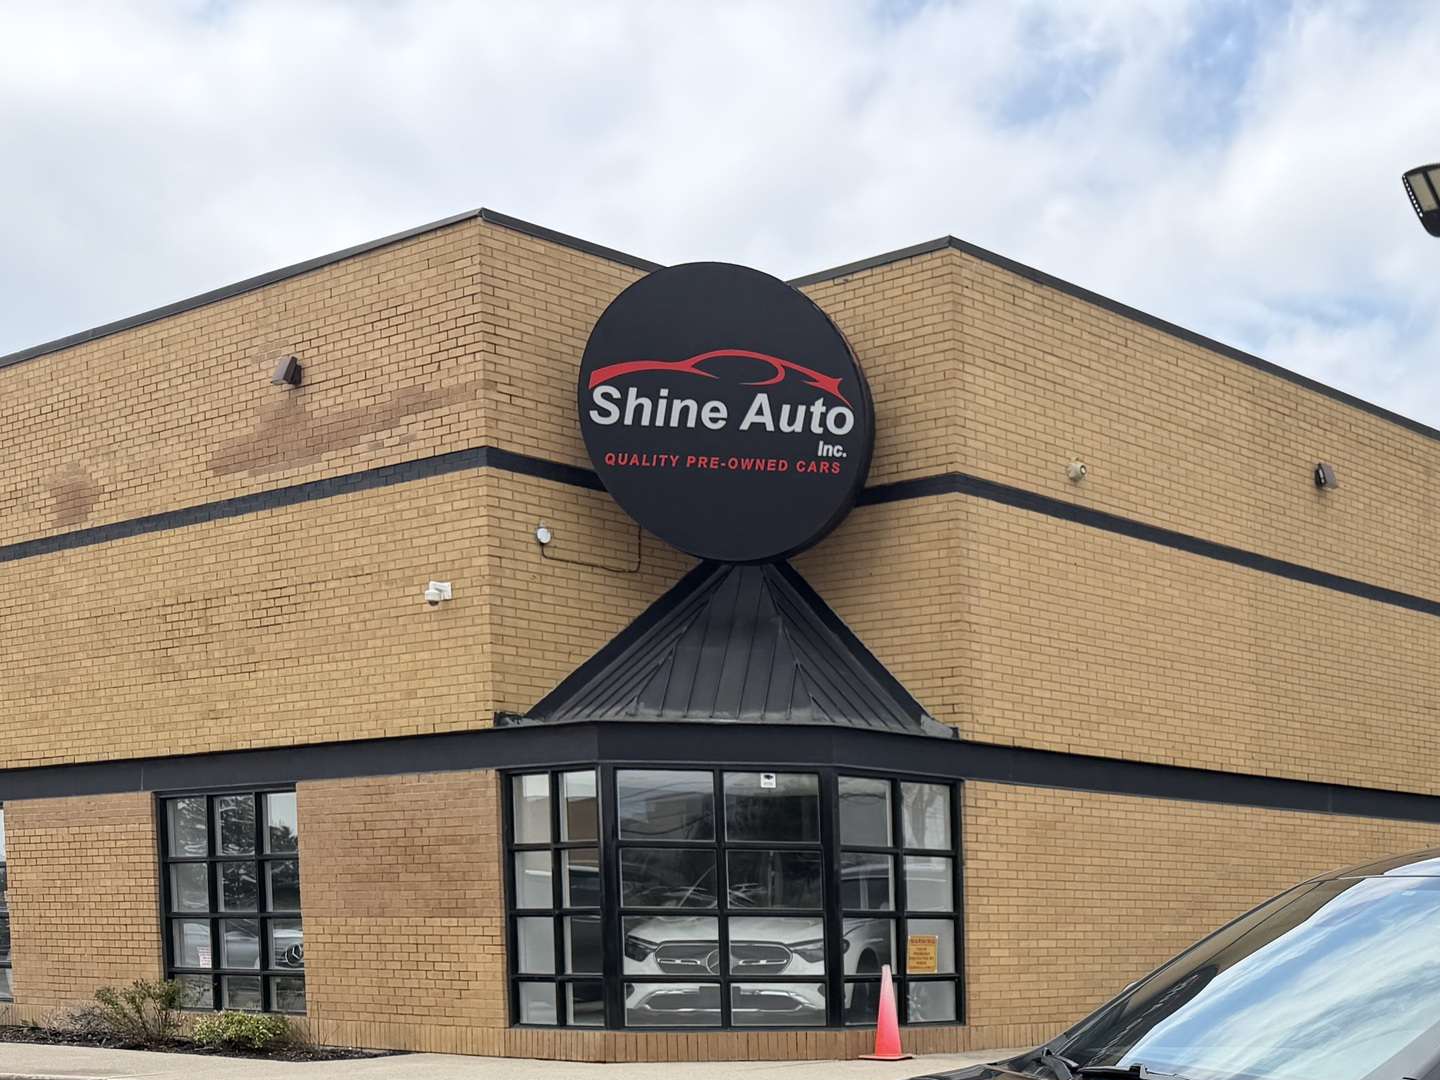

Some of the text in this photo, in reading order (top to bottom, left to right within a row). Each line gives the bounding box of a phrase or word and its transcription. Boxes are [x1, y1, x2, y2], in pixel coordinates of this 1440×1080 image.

[589, 385, 855, 436] Shine Auto
[817, 440, 848, 458] Inc.
[604, 452, 841, 474] QUALITY PRE-OWNED CARS
